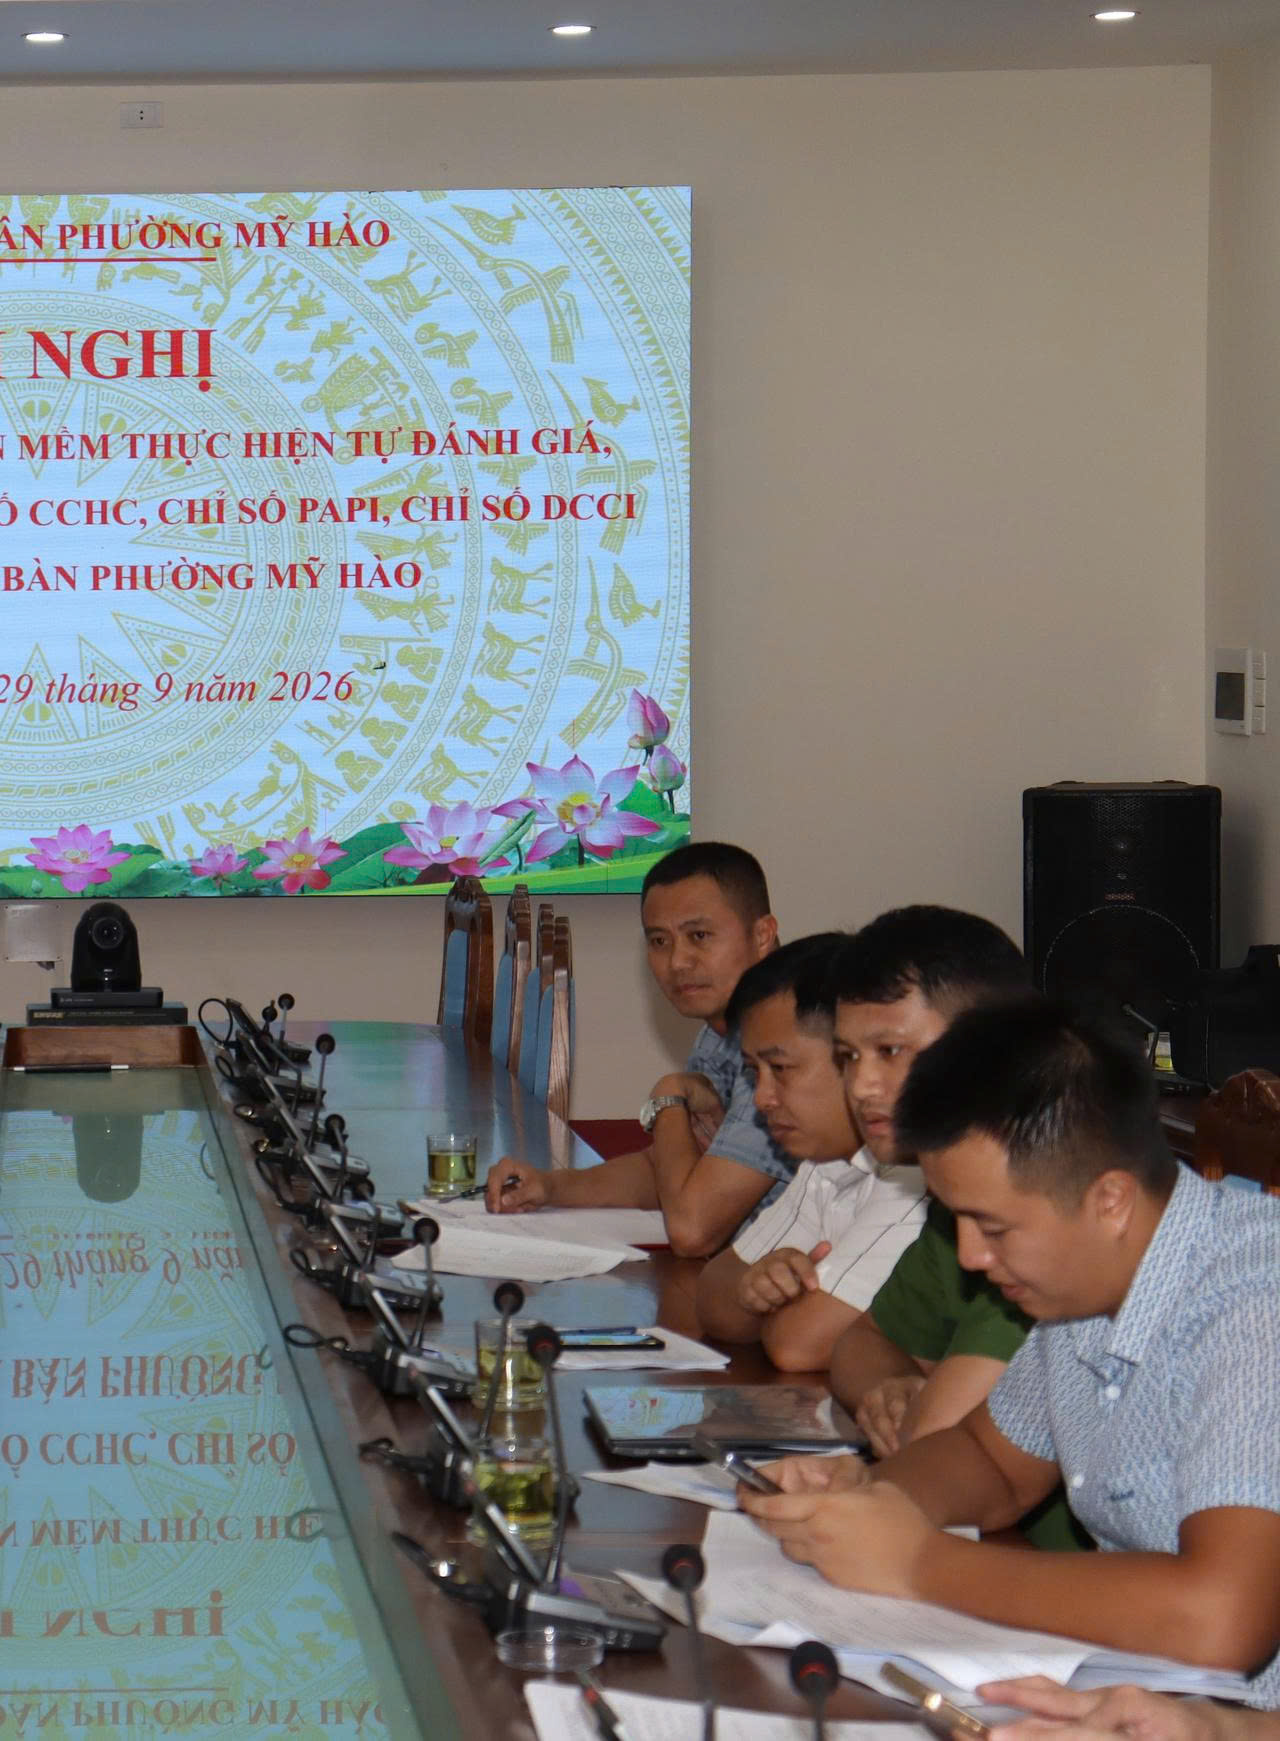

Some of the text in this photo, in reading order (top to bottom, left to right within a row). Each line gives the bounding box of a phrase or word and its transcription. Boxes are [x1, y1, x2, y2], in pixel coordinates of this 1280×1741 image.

[58, 217, 223, 250] PHƯỜNG
[235, 214, 292, 249] MỸ
[307, 212, 390, 248] HÀO
[28, 329, 216, 393] NGHỊ
[18, 426, 110, 461] MỀM
[122, 429, 231, 467] THỰC
[242, 428, 336, 465] HIỆN
[346, 425, 403, 465] TỰ
[411, 421, 519, 457] ĐÁNH
[531, 419, 612, 459] GIÁ,
[28, 498, 148, 529] CCHC,
[157, 490, 226, 526] CHỈ
[238, 488, 287, 526] SỐ
[298, 496, 391, 526] PAPI,
[400, 487, 471, 523] CHỈ
[481, 485, 532, 522] SỐ
[542, 493, 637, 521] DCCI
[2, 557, 78, 592] BÀN
[91, 556, 255, 592] PHƯỜNG
[266, 556, 325, 590] MỸ
[338, 553, 422, 589] HÀO
[45, 672, 143, 712] tháng
[154, 671, 174, 703] 9
[184, 671, 257, 703] năm
[268, 670, 355, 703] 2026
